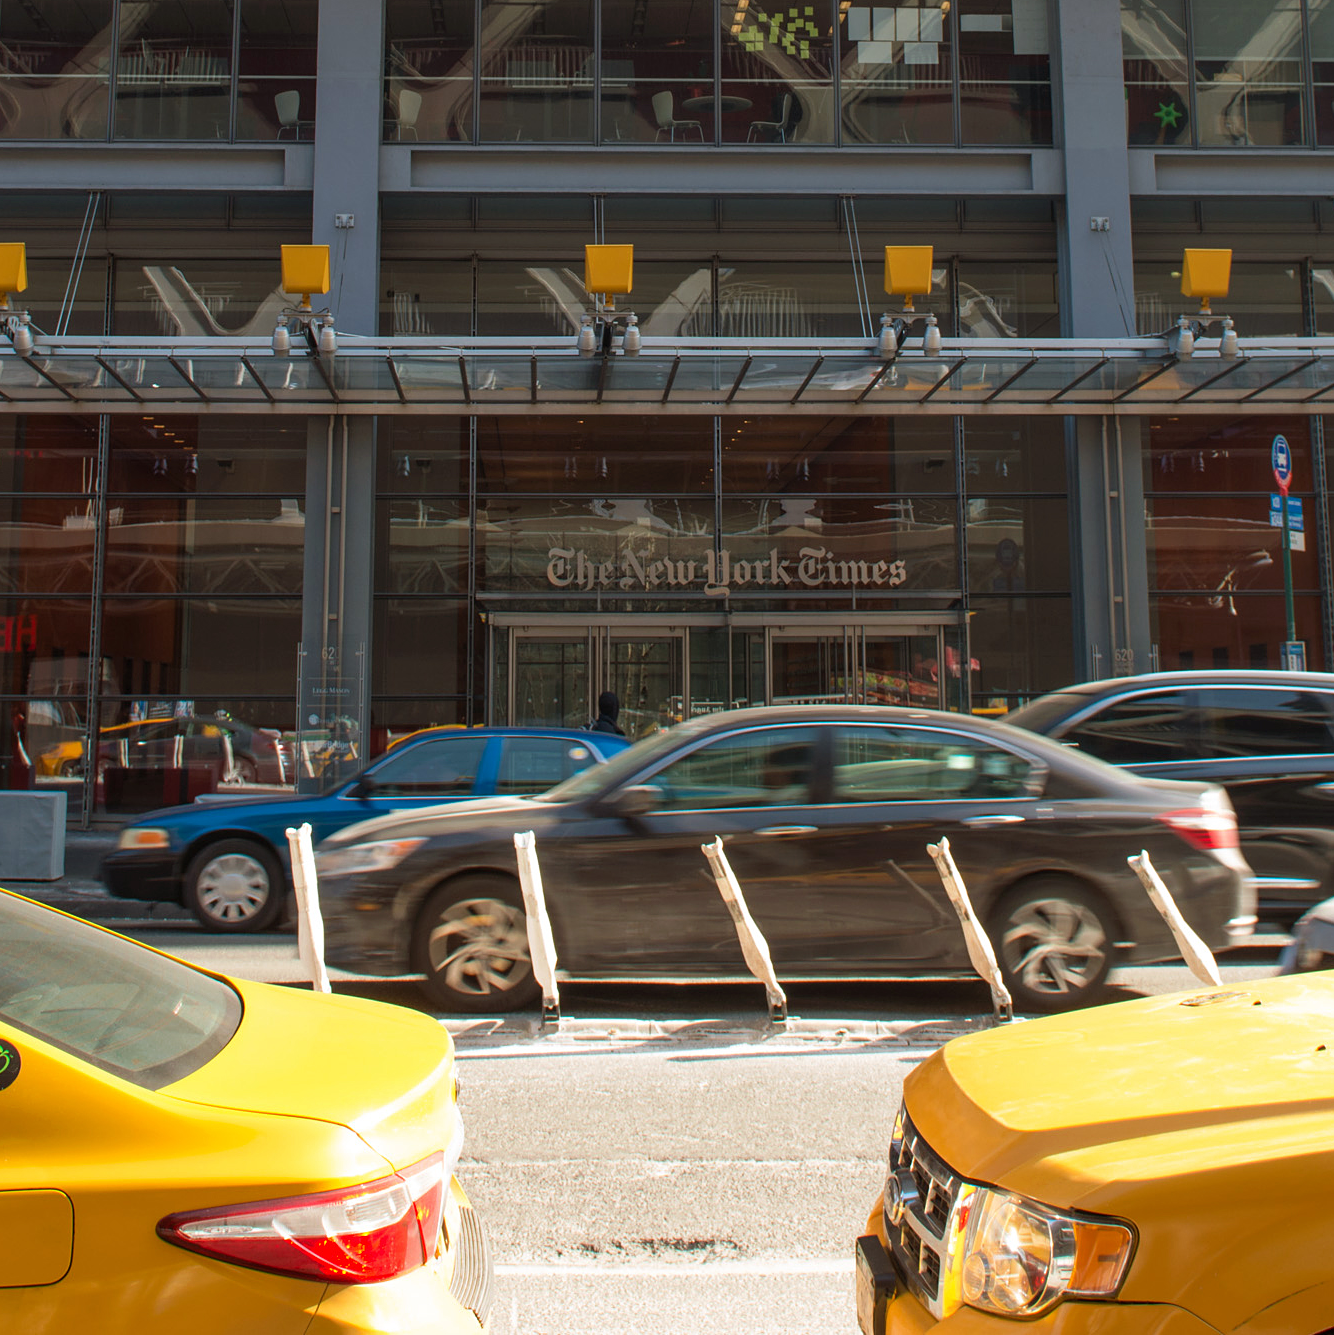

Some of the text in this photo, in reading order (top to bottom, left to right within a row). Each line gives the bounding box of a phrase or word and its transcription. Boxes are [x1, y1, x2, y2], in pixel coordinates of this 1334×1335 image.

[547, 546, 907, 598] The New York Times
